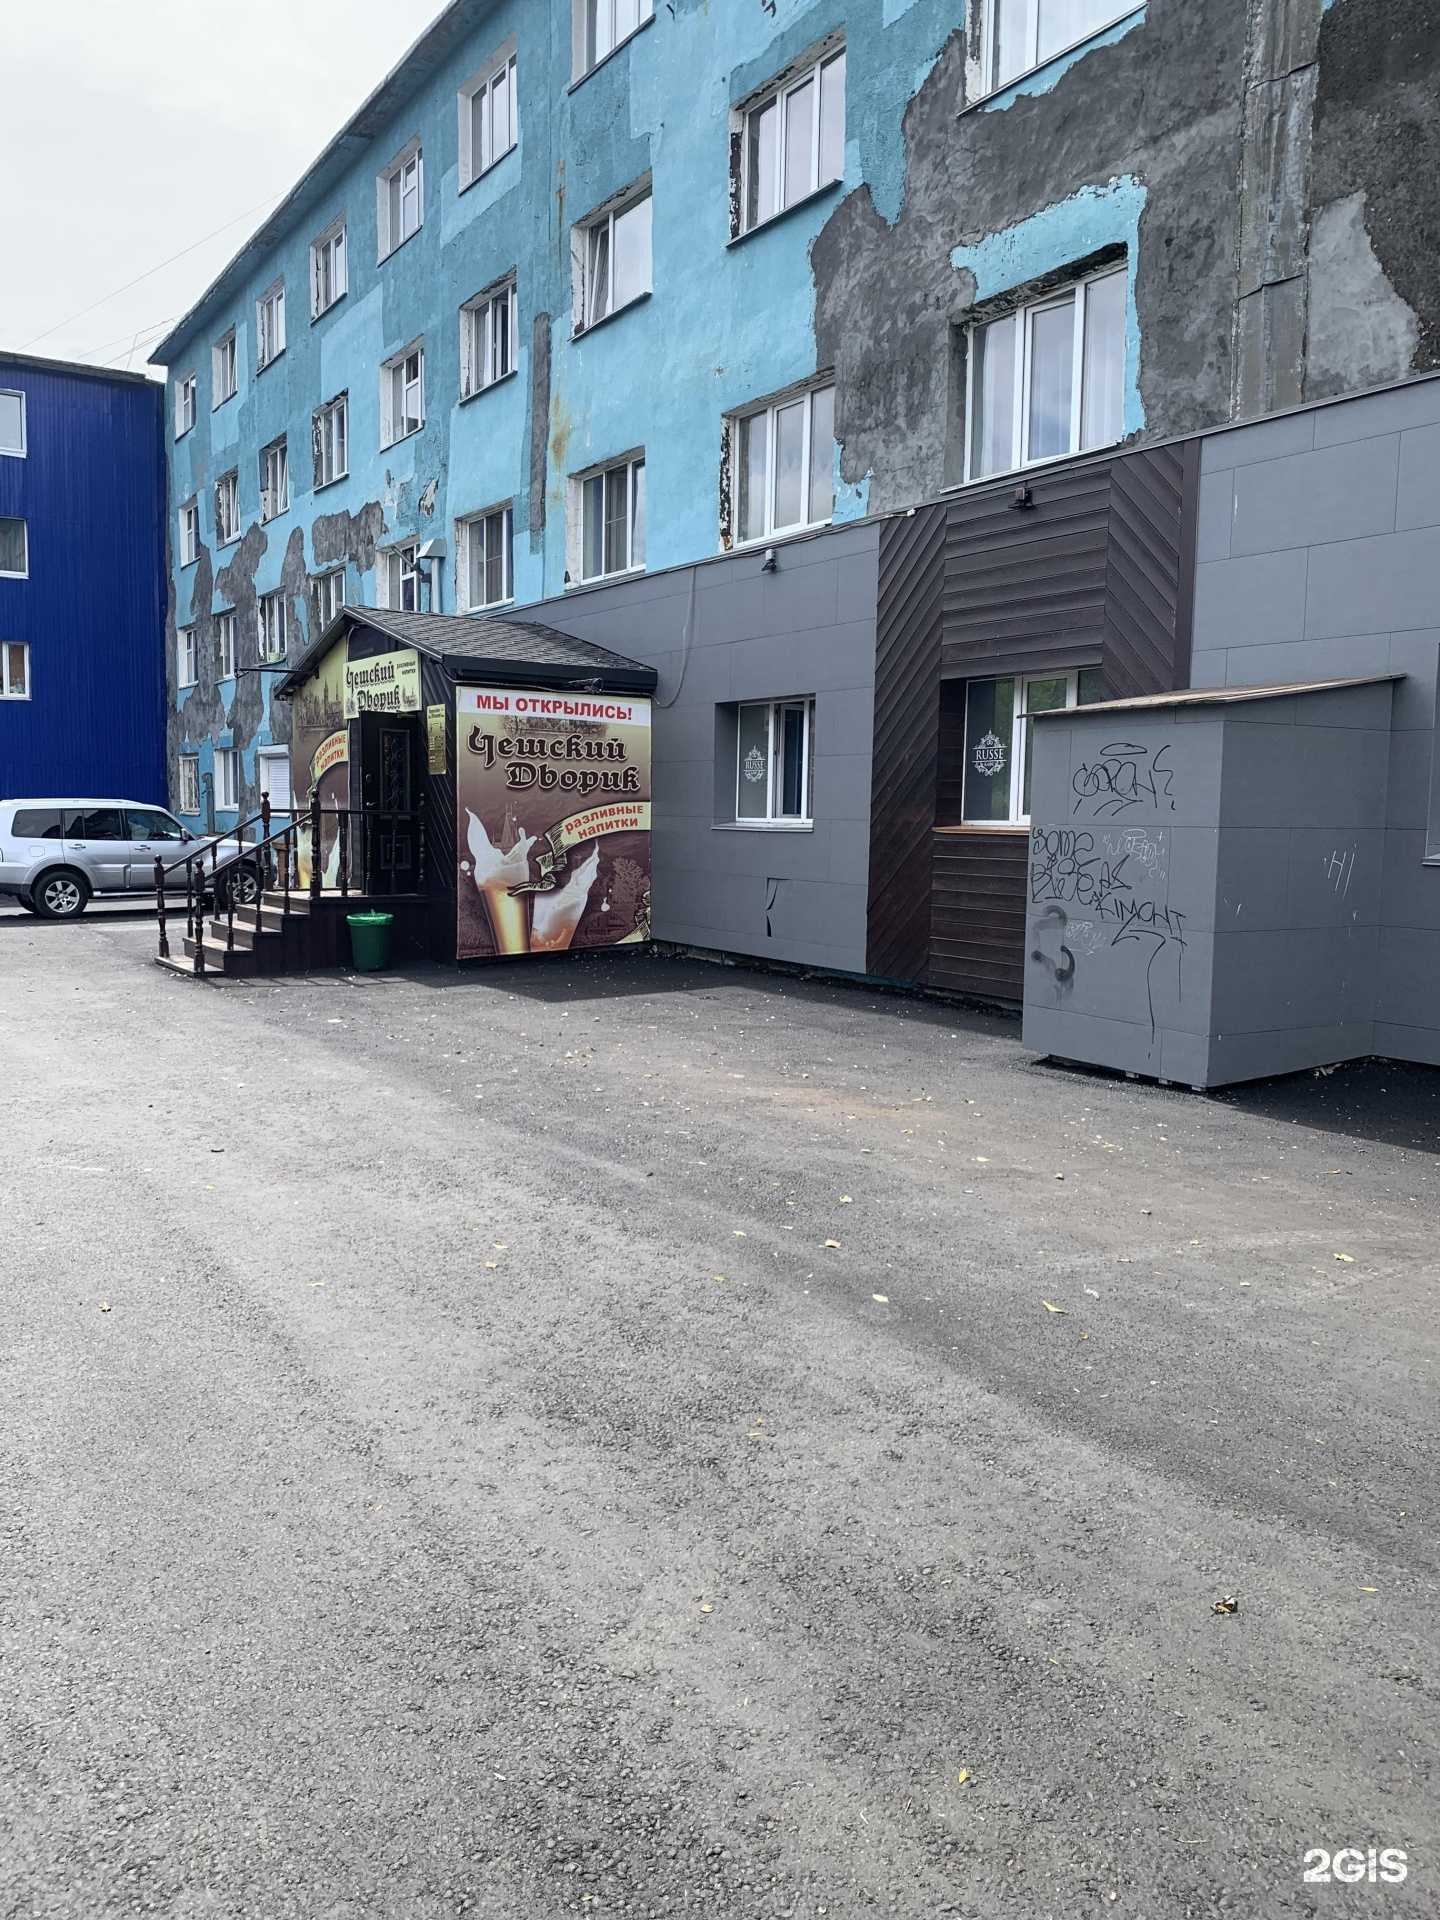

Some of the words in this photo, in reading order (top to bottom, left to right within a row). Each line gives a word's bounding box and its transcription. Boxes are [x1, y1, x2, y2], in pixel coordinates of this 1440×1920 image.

[476, 695, 509, 711] МЫ
[515, 698, 632, 721] ОТКРЫЛИСЬ!
[468, 725, 627, 768] Чешский
[976, 749, 1005, 760] RUSSE
[506, 762, 641, 794] Дворик
